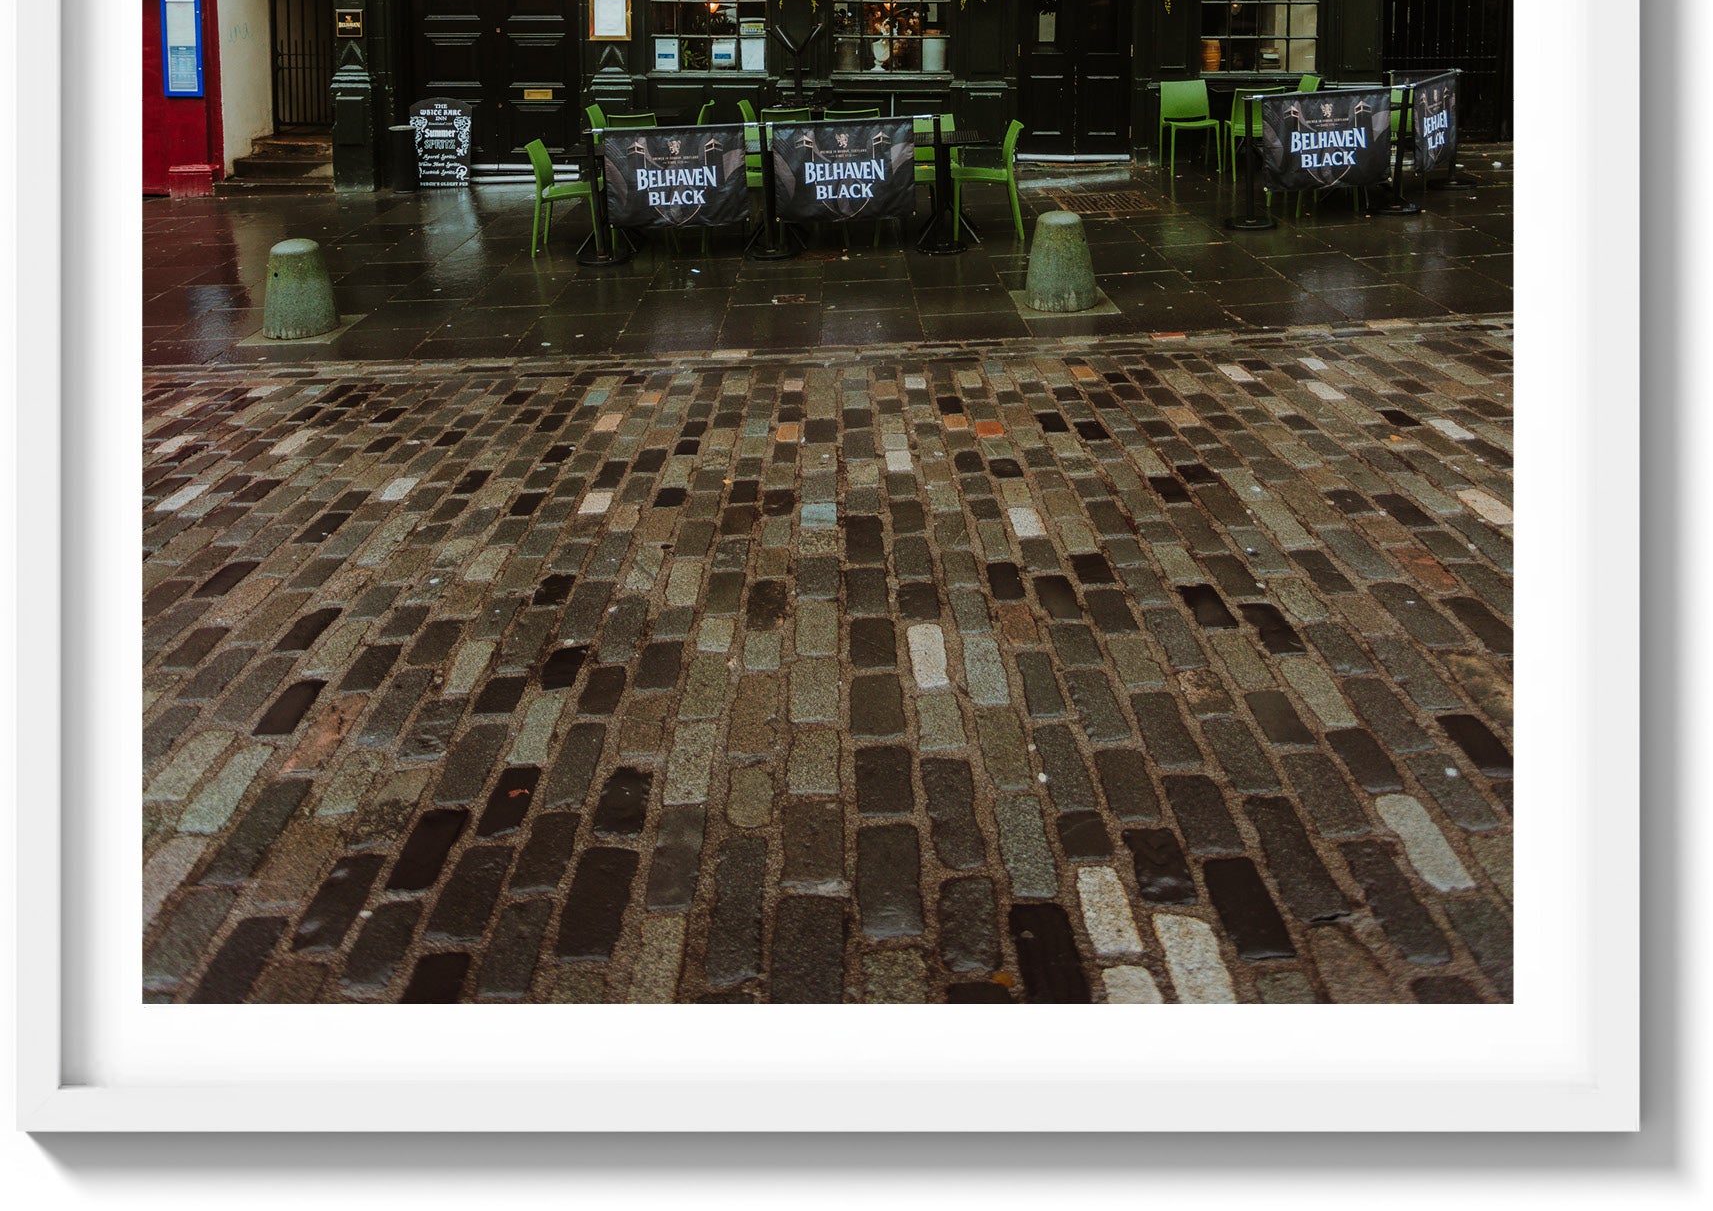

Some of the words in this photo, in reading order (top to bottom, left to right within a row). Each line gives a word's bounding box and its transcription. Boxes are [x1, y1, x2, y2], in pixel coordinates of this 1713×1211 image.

[425, 128, 455, 138] Summer
[1290, 127, 1367, 153] BELHAVEN
[1301, 150, 1356, 168] BLACK
[636, 165, 717, 191] BELHAVEN
[804, 159, 885, 184] BELHAVEN
[648, 189, 706, 206] BLACK
[816, 183, 874, 200] BLACK
